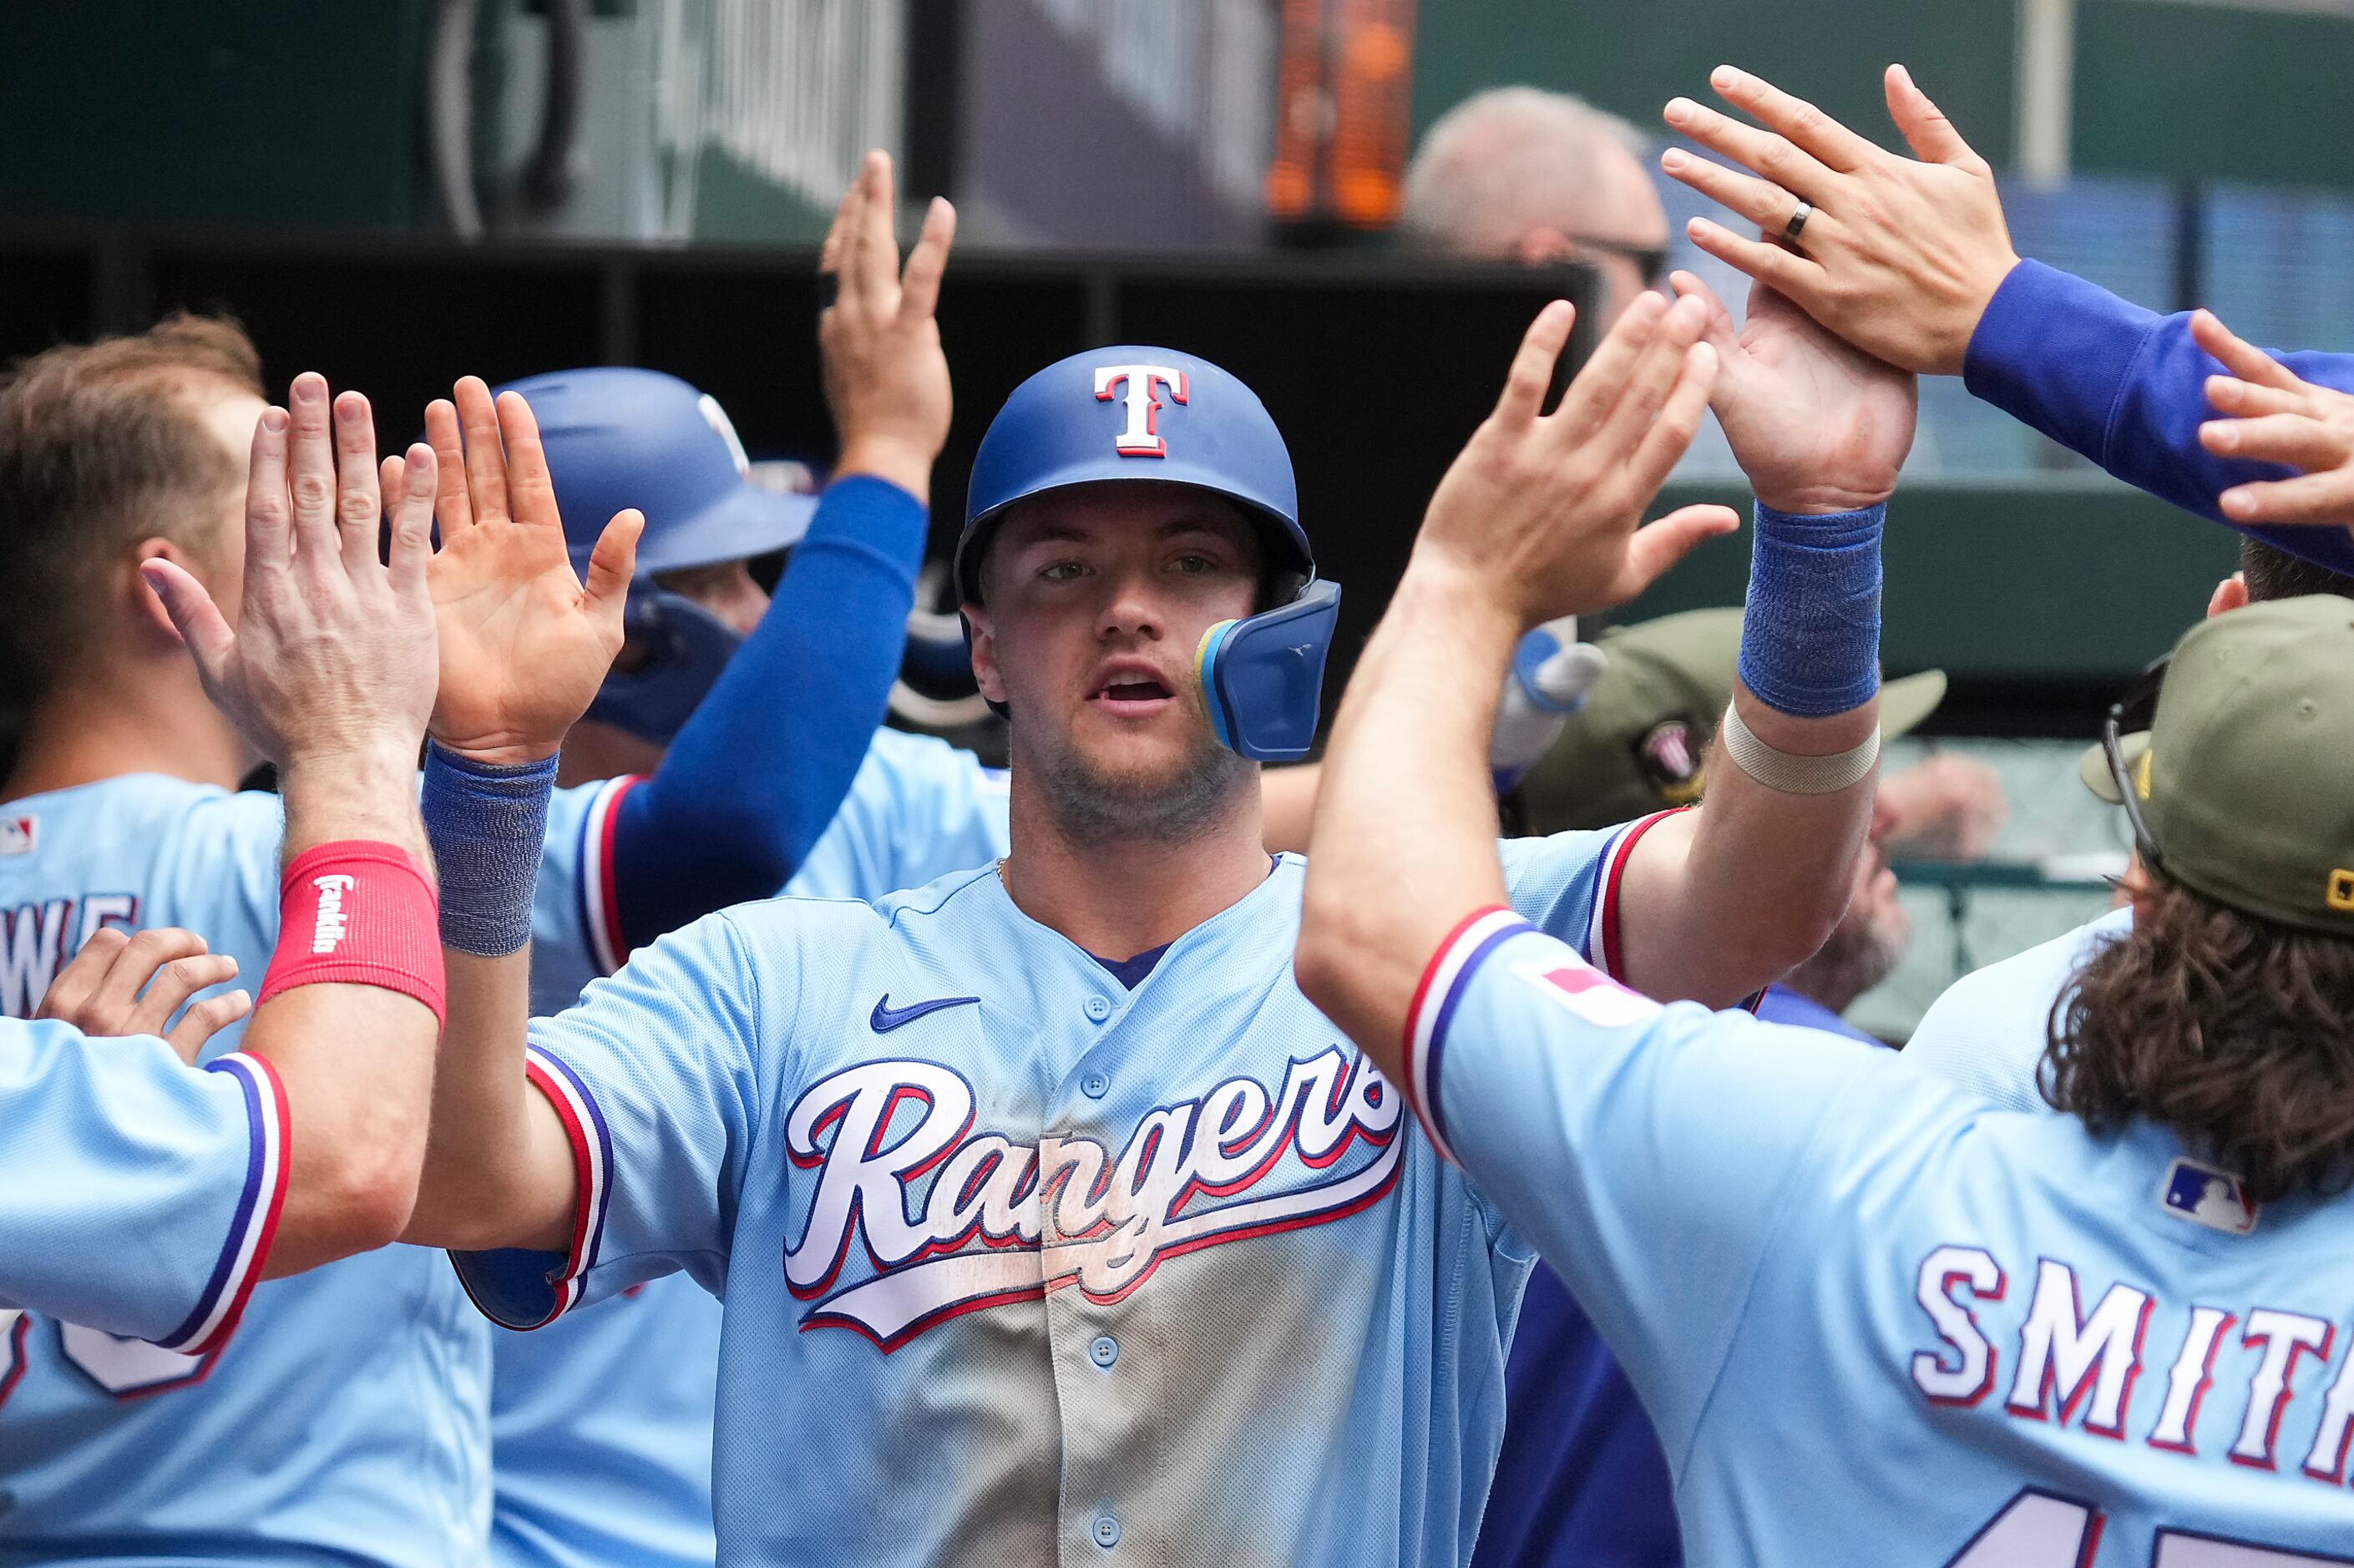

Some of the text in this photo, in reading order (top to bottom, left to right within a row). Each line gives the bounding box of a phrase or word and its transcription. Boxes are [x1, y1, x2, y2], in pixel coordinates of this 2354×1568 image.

[1094, 364, 1189, 459] T
[312, 874, 355, 953] Franklin
[783, 1044, 1403, 1308] Rangers
